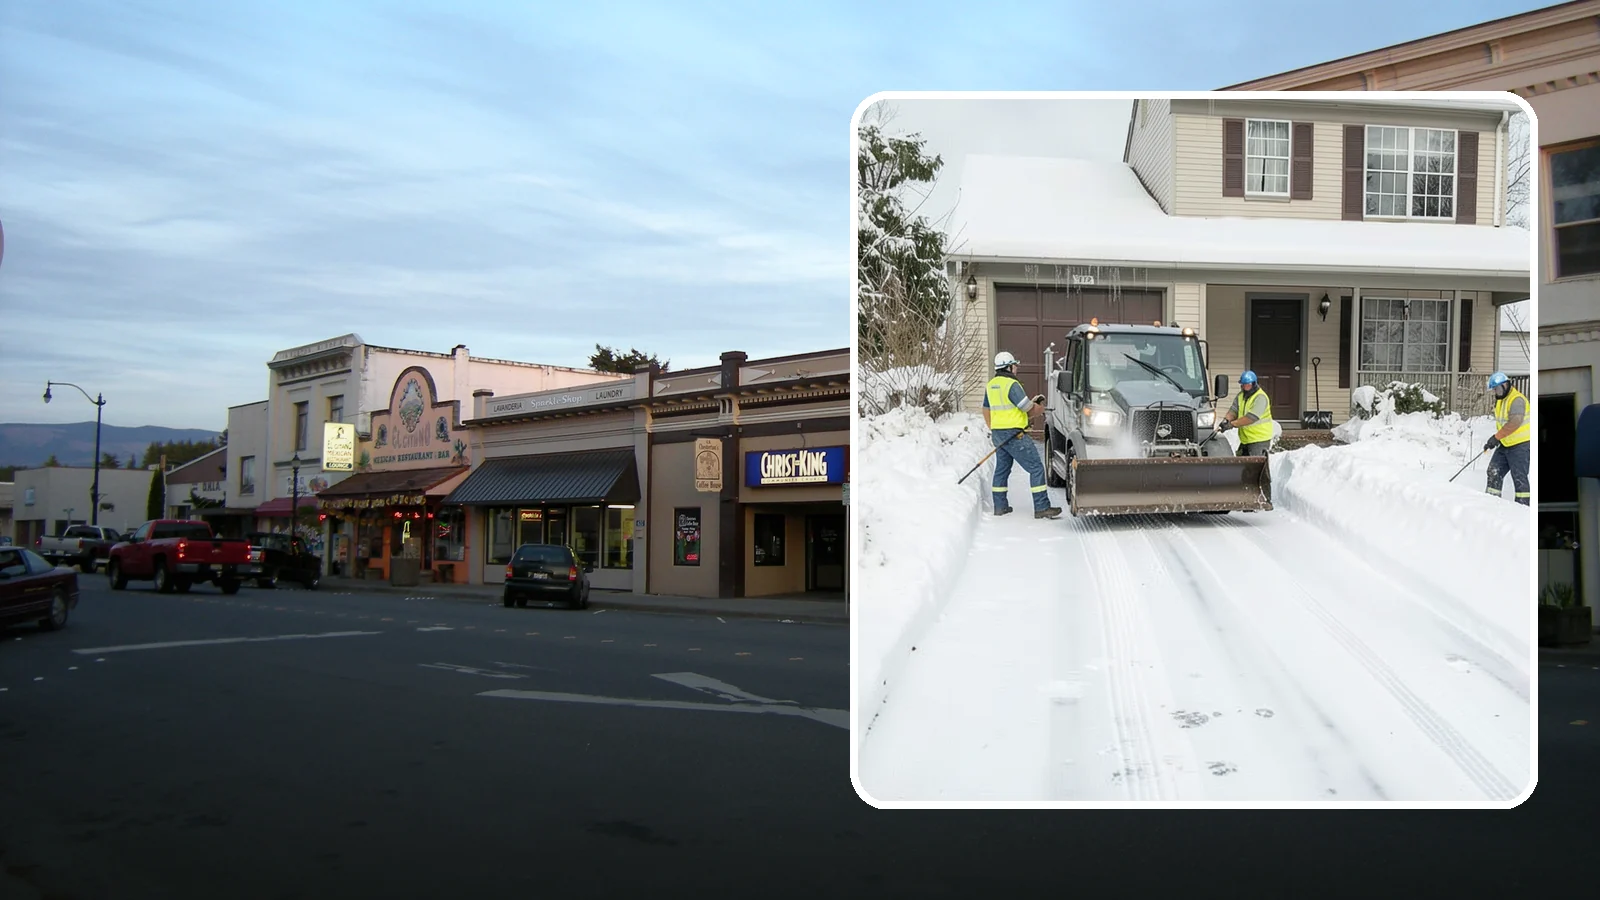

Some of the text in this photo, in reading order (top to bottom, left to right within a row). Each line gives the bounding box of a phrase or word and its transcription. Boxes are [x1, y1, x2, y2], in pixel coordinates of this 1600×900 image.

[562, 395, 583, 404] Shop
[596, 389, 624, 400] LAUNDRY
[494, 402, 523, 412] LAVANDERIA
[373, 455, 396, 464] MEXICAN
[398, 452, 433, 462] RESTAURANT
[438, 450, 450, 458] BAR
[761, 450, 827, 478] CHRIST KING
